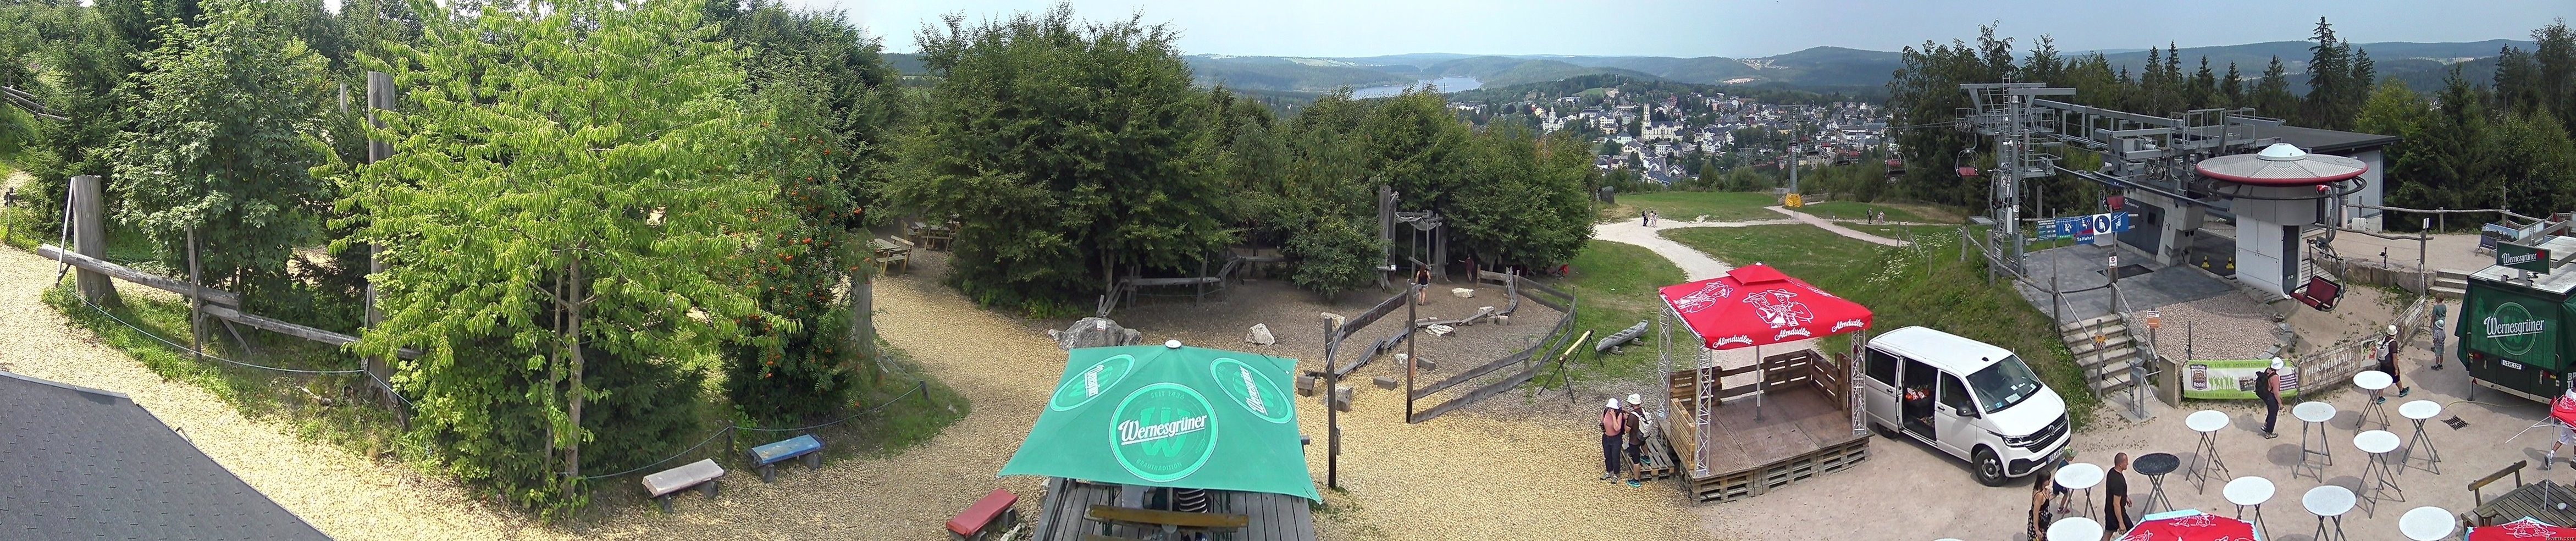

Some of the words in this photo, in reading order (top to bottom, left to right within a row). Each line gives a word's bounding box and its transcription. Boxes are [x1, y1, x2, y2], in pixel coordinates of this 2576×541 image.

[2501, 252, 2537, 264] Wernesgrüner
[1832, 319, 1864, 333] Almdudler
[2484, 316, 2544, 335] Wernesgrüner
[1712, 334, 1753, 348] Almdudler
[1775, 327, 1811, 341] Almdudler
[1168, 391, 1185, 399] 1436
[1118, 415, 1207, 442] Wernesgrüner
[1136, 458, 1182, 471] BRAUTRADITION
